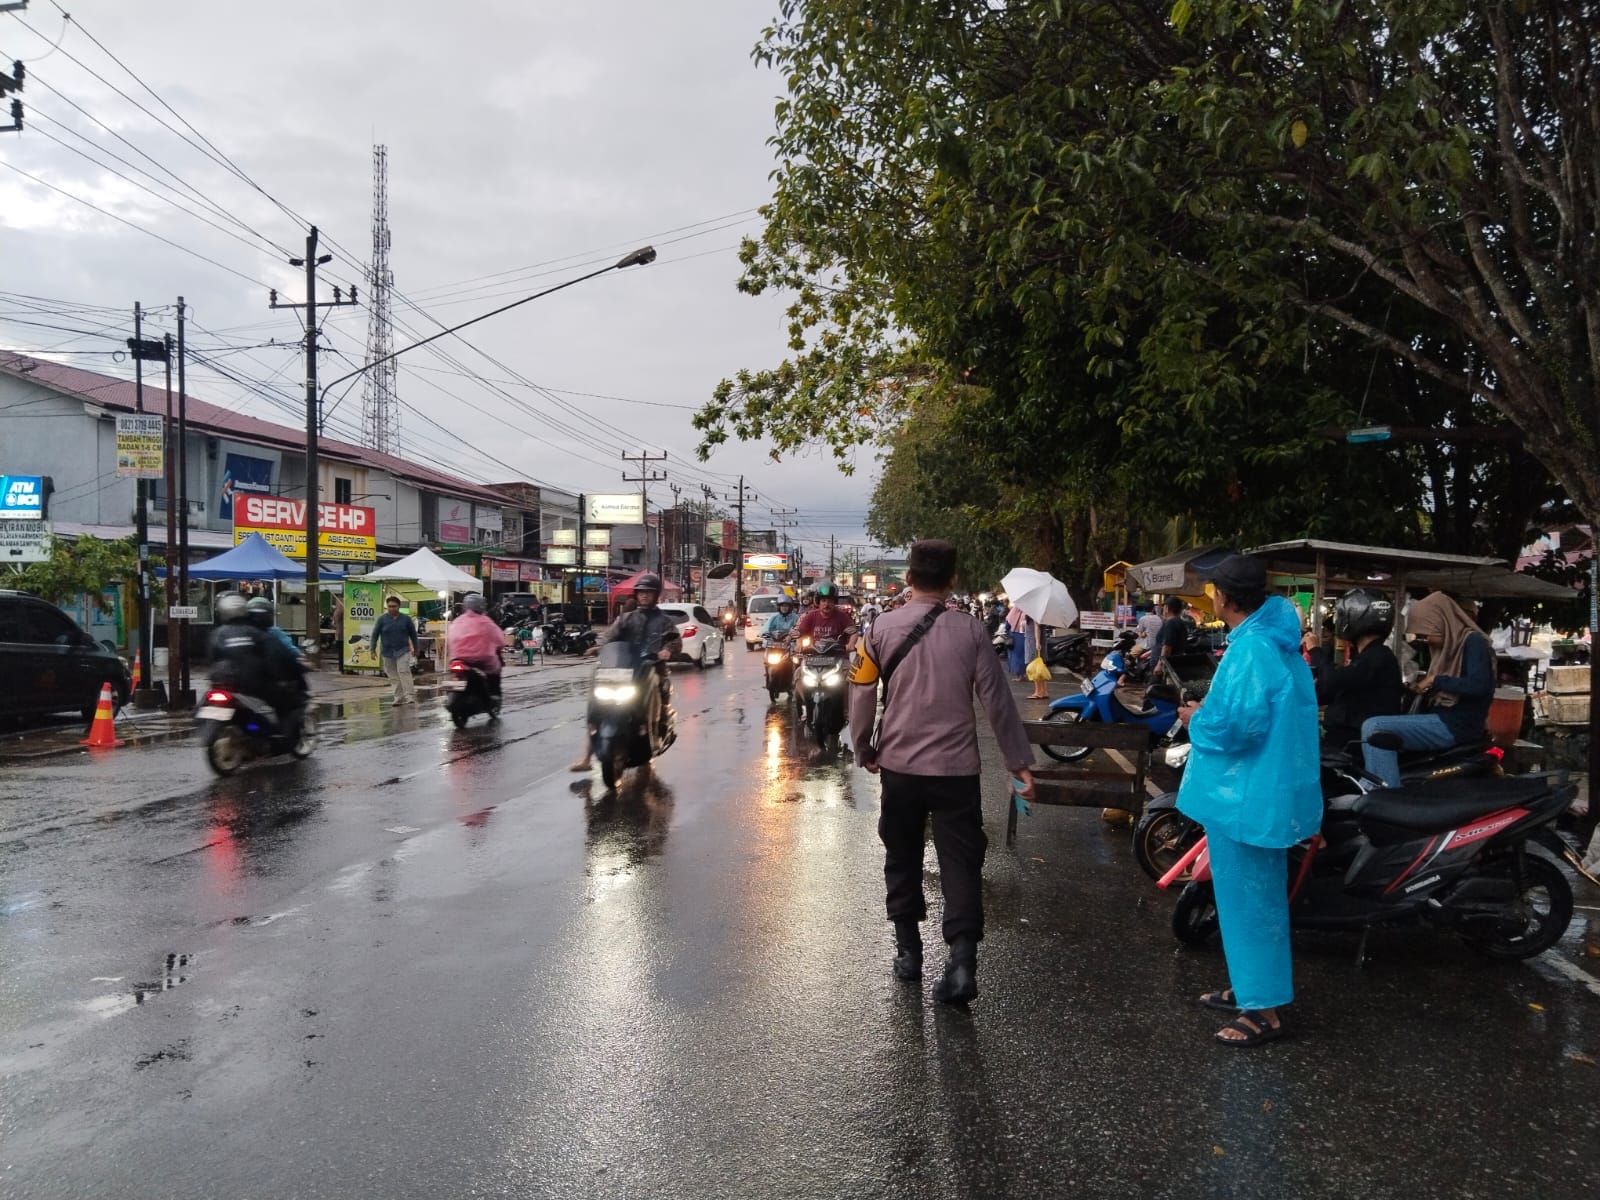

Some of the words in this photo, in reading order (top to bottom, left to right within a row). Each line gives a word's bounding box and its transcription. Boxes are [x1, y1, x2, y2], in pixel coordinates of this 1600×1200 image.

[9, 481, 35, 493] ATM
[17, 494, 40, 505] BCA
[247, 497, 337, 528] SERVCE
[339, 507, 366, 530] HP
[25, 522, 48, 532] MOBIL
[1152, 573, 1173, 582] Biznet
[350, 607, 375, 617] 6000
